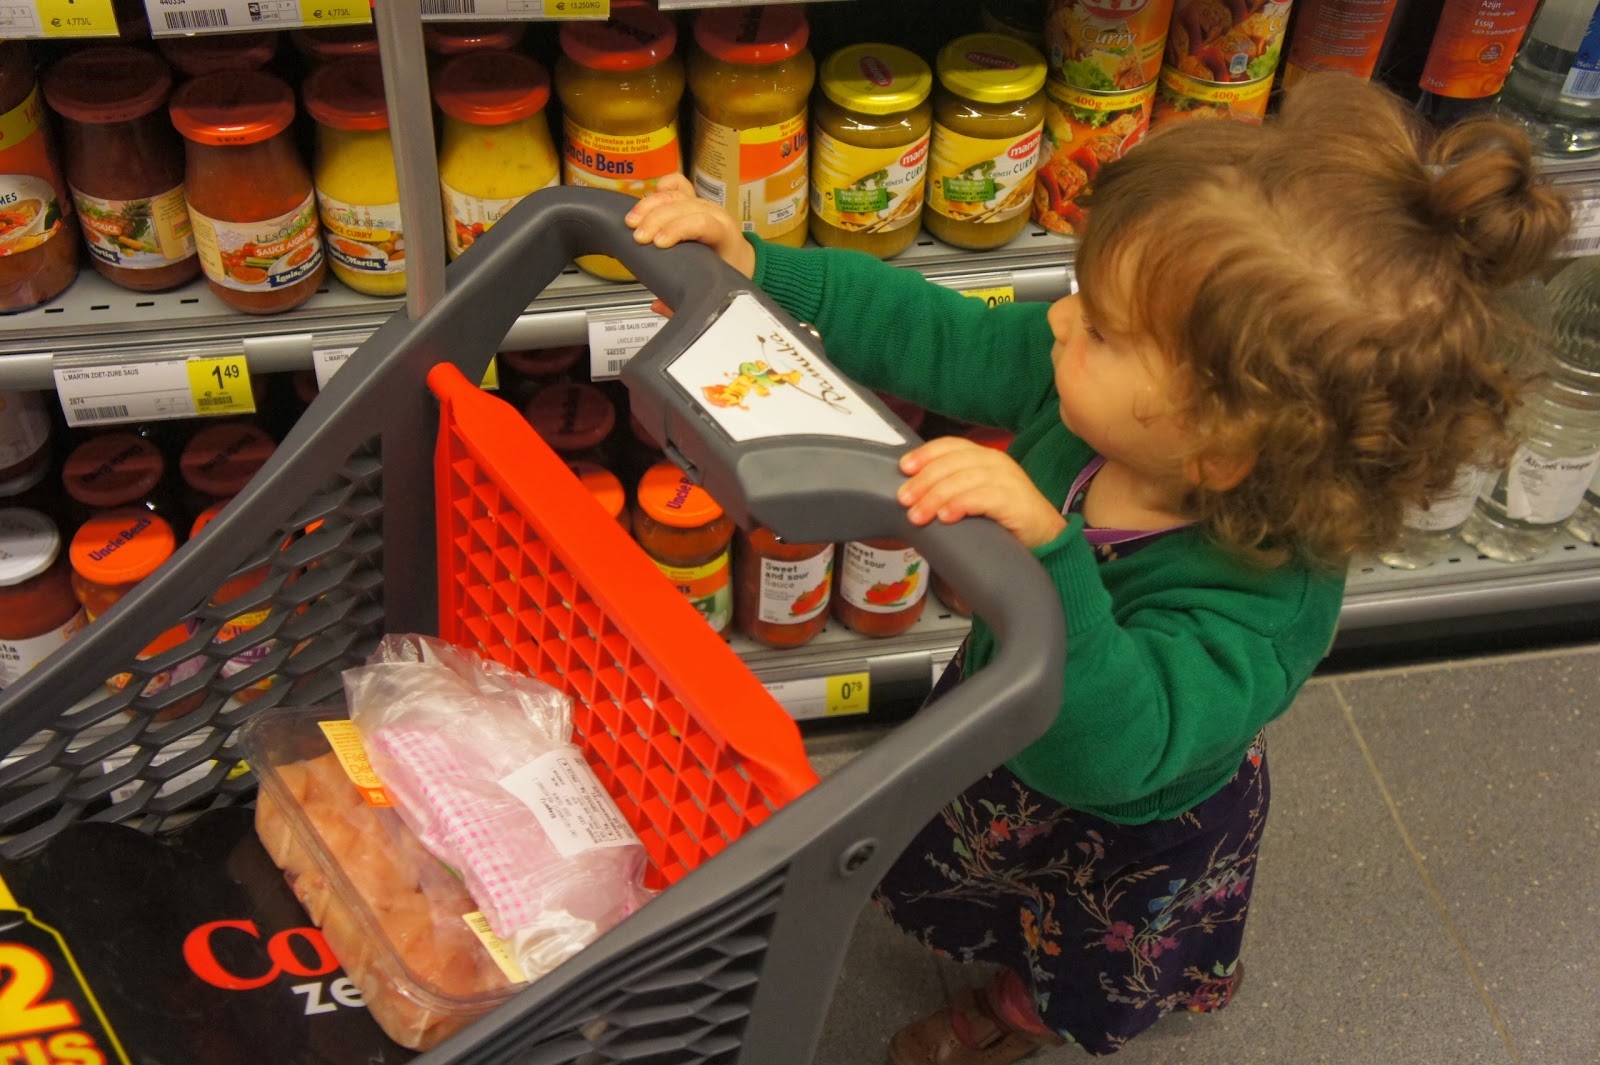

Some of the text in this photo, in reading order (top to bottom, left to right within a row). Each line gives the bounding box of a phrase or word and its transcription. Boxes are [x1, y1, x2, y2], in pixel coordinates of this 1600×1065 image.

[1474, 18, 1494, 29] Essig
[1082, 25, 1137, 51] Curry
[1212, 90, 1240, 101] 400g
[1074, 95, 1102, 110] 400g
[595, 152, 635, 175] Ben's
[346, 229, 373, 240] CURRY
[256, 244, 285, 258] SAUCE
[286, 233, 307, 250] AIGRE
[63, 368, 139, 381] L.MARTIN ZOET-ZURE SAUS
[667, 484, 690, 510] Uncle
[87, 536, 123, 563] Uncle
[765, 562, 798, 573] Sweet
[864, 560, 886, 569] sour
[765, 572, 809, 581] and sour
[765, 579, 795, 589] Sauce
